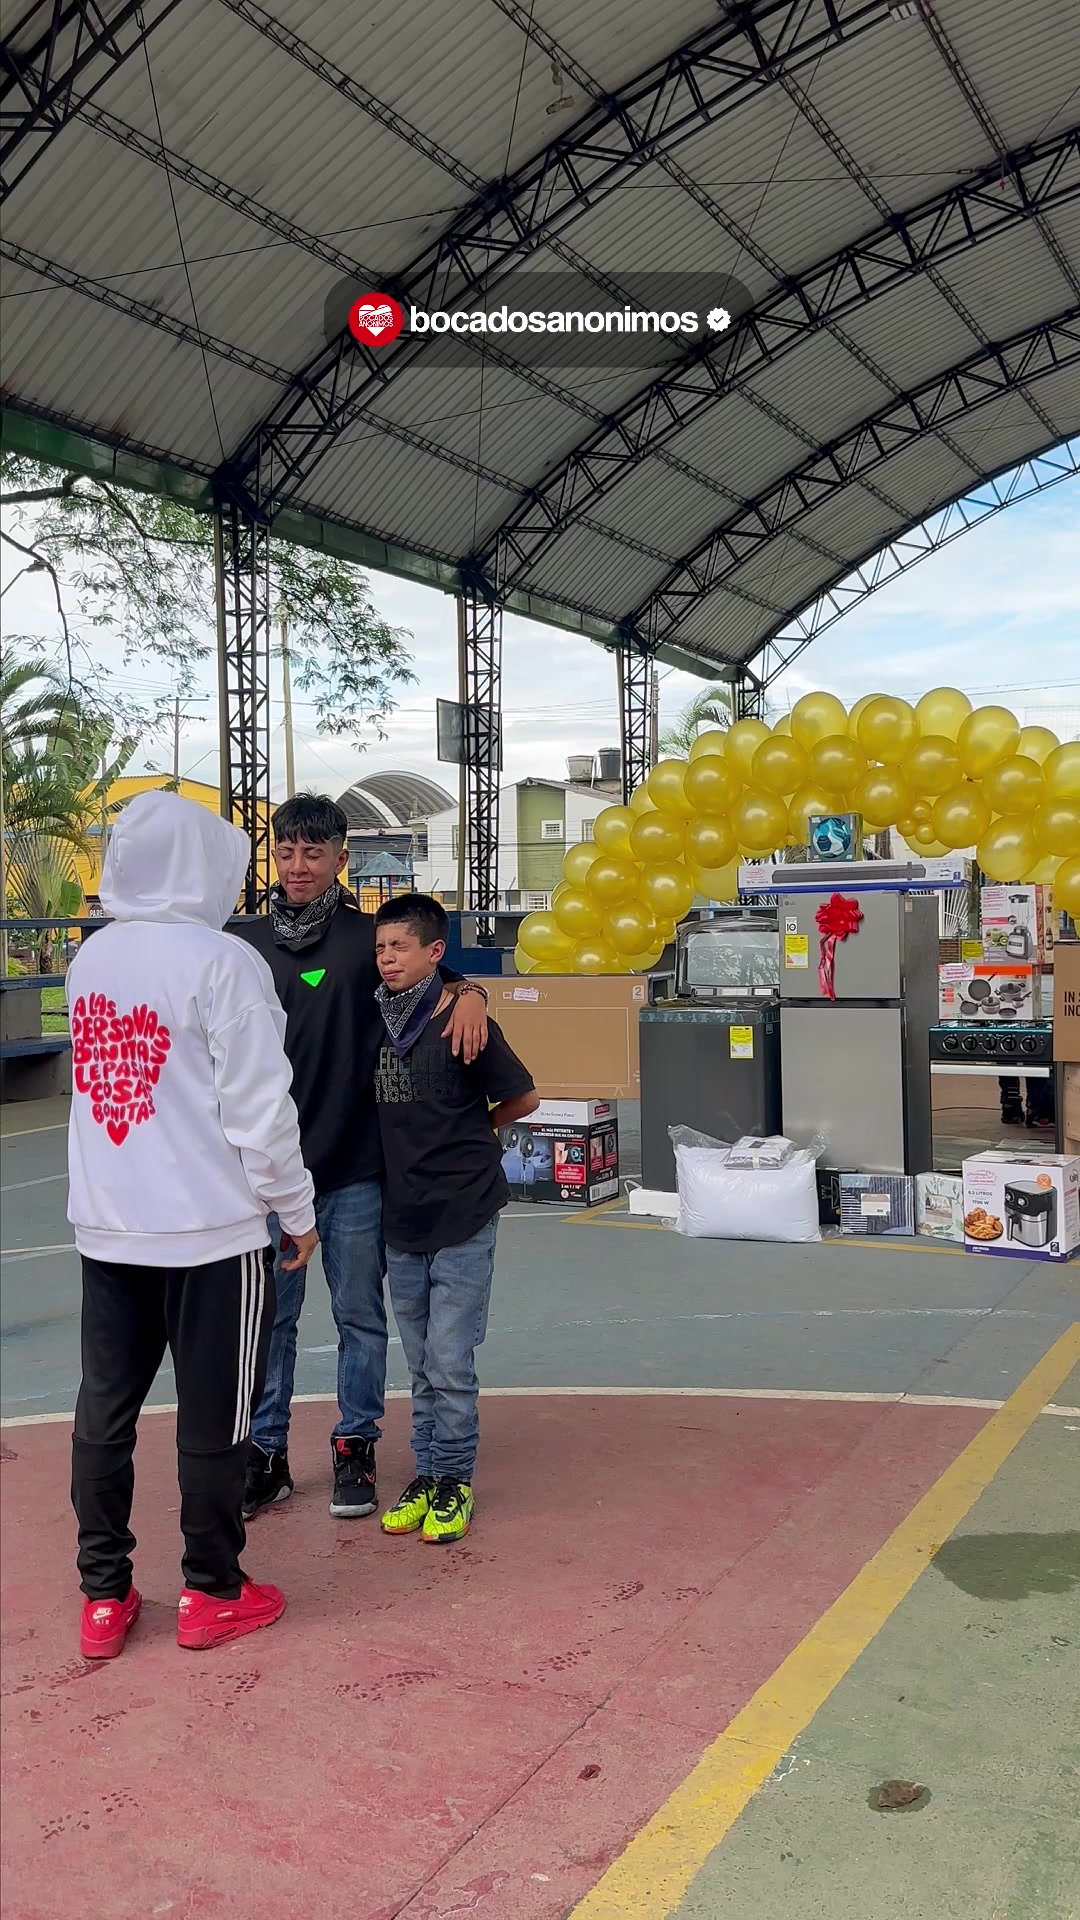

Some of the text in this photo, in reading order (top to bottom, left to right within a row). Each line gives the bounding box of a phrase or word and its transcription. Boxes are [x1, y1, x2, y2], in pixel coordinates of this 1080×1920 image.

[90, 910, 104, 918] PARE
[786, 923, 796, 932] 10
[635, 986, 642, 996] 2
[1064, 990, 1075, 1003] IN
[74, 992, 117, 1018] A LAS
[72, 1003, 172, 1052] PERSONAS
[73, 1038, 168, 1065] BONITAS
[90, 1079, 154, 1103] COSAS
[92, 1101, 156, 1125] BONITAS
[1051, 1242, 1058, 1250] 2
